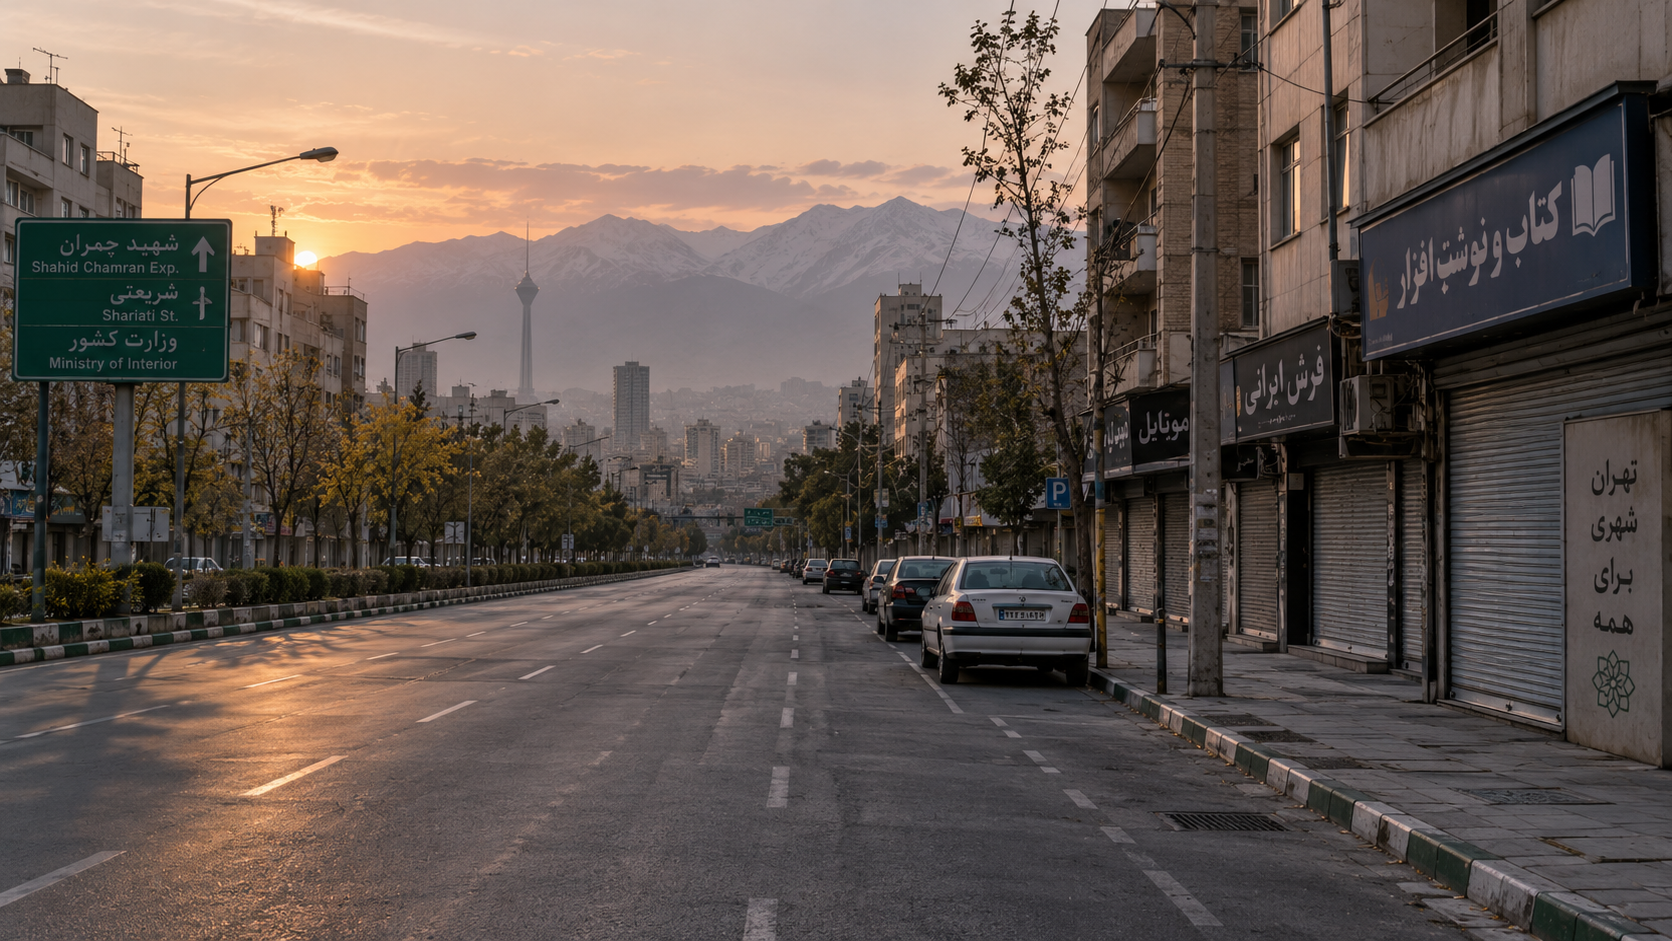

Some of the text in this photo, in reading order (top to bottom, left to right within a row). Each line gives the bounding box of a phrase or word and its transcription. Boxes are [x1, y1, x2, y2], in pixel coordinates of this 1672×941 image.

[1505, 181, 1562, 267] کتاب
[60, 234, 179, 257] شهید چمران
[1490, 230, 1503, 278] و
[32, 261, 179, 276] Shahid Chamran Exp.
[110, 283, 179, 305] شریعتی
[102, 309, 179, 321] Shariati St.
[68, 330, 177, 352] وزارت کشور
[49, 357, 178, 372] Ministry of Interior
[1287, 345, 1324, 405] فرش
[1591, 459, 1638, 496] تهران
[1052, 482, 1067, 500] P
[1590, 506, 1638, 542] شهری
[1593, 557, 1634, 594] برای
[1593, 611, 1634, 635] همه
